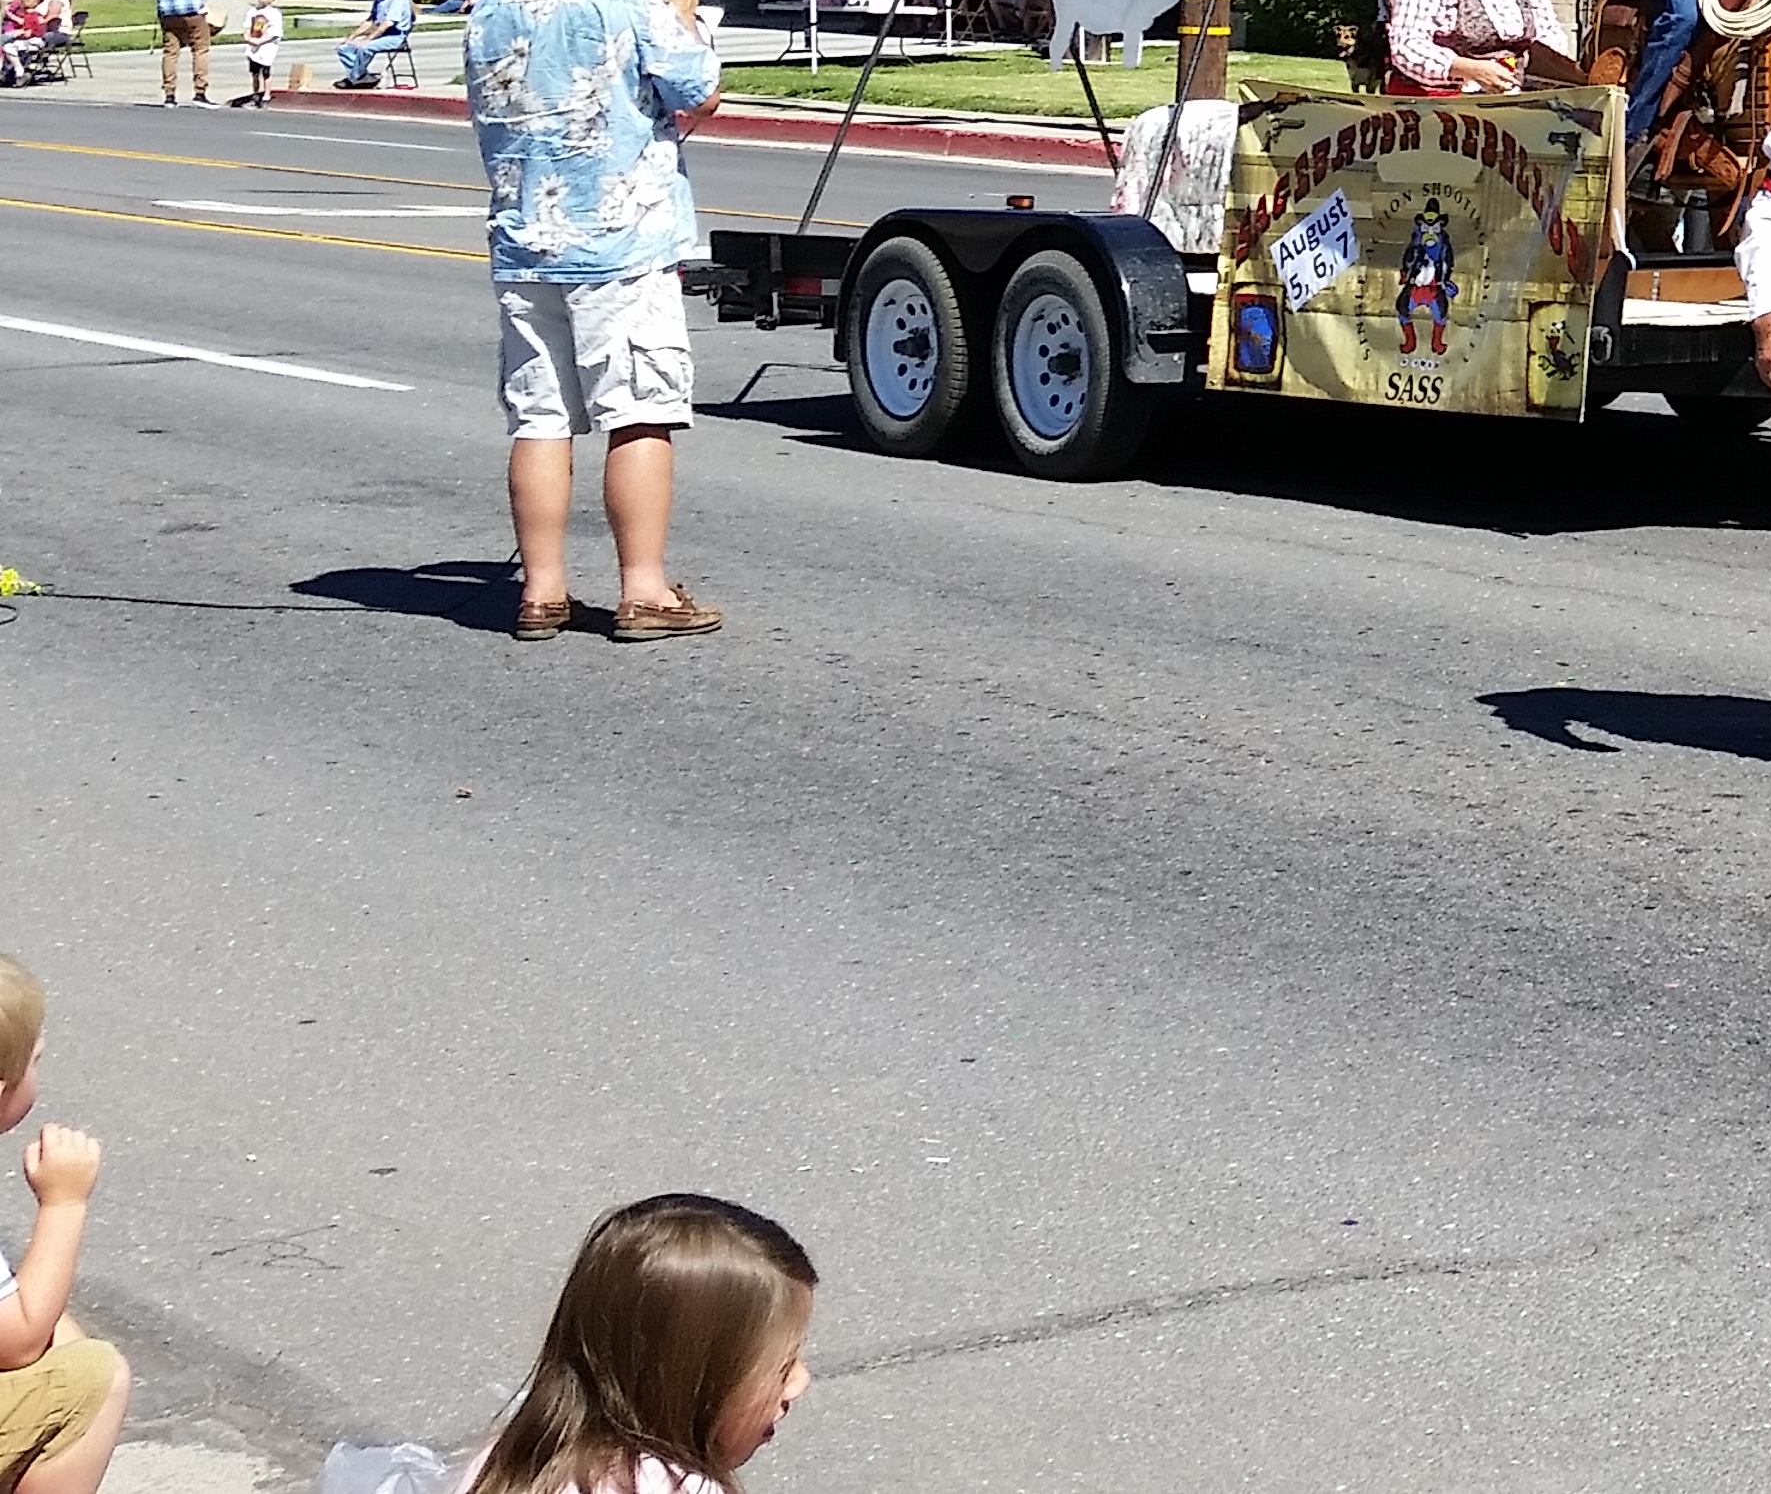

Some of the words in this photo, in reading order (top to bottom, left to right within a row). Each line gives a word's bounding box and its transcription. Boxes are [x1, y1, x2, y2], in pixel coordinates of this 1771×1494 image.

[1278, 195, 1350, 270] August
[1289, 273, 1311, 302] 5,
[1312, 252, 1335, 279] 6,
[1335, 231, 1349, 260] 7
[1384, 372, 1444, 404] SASS
